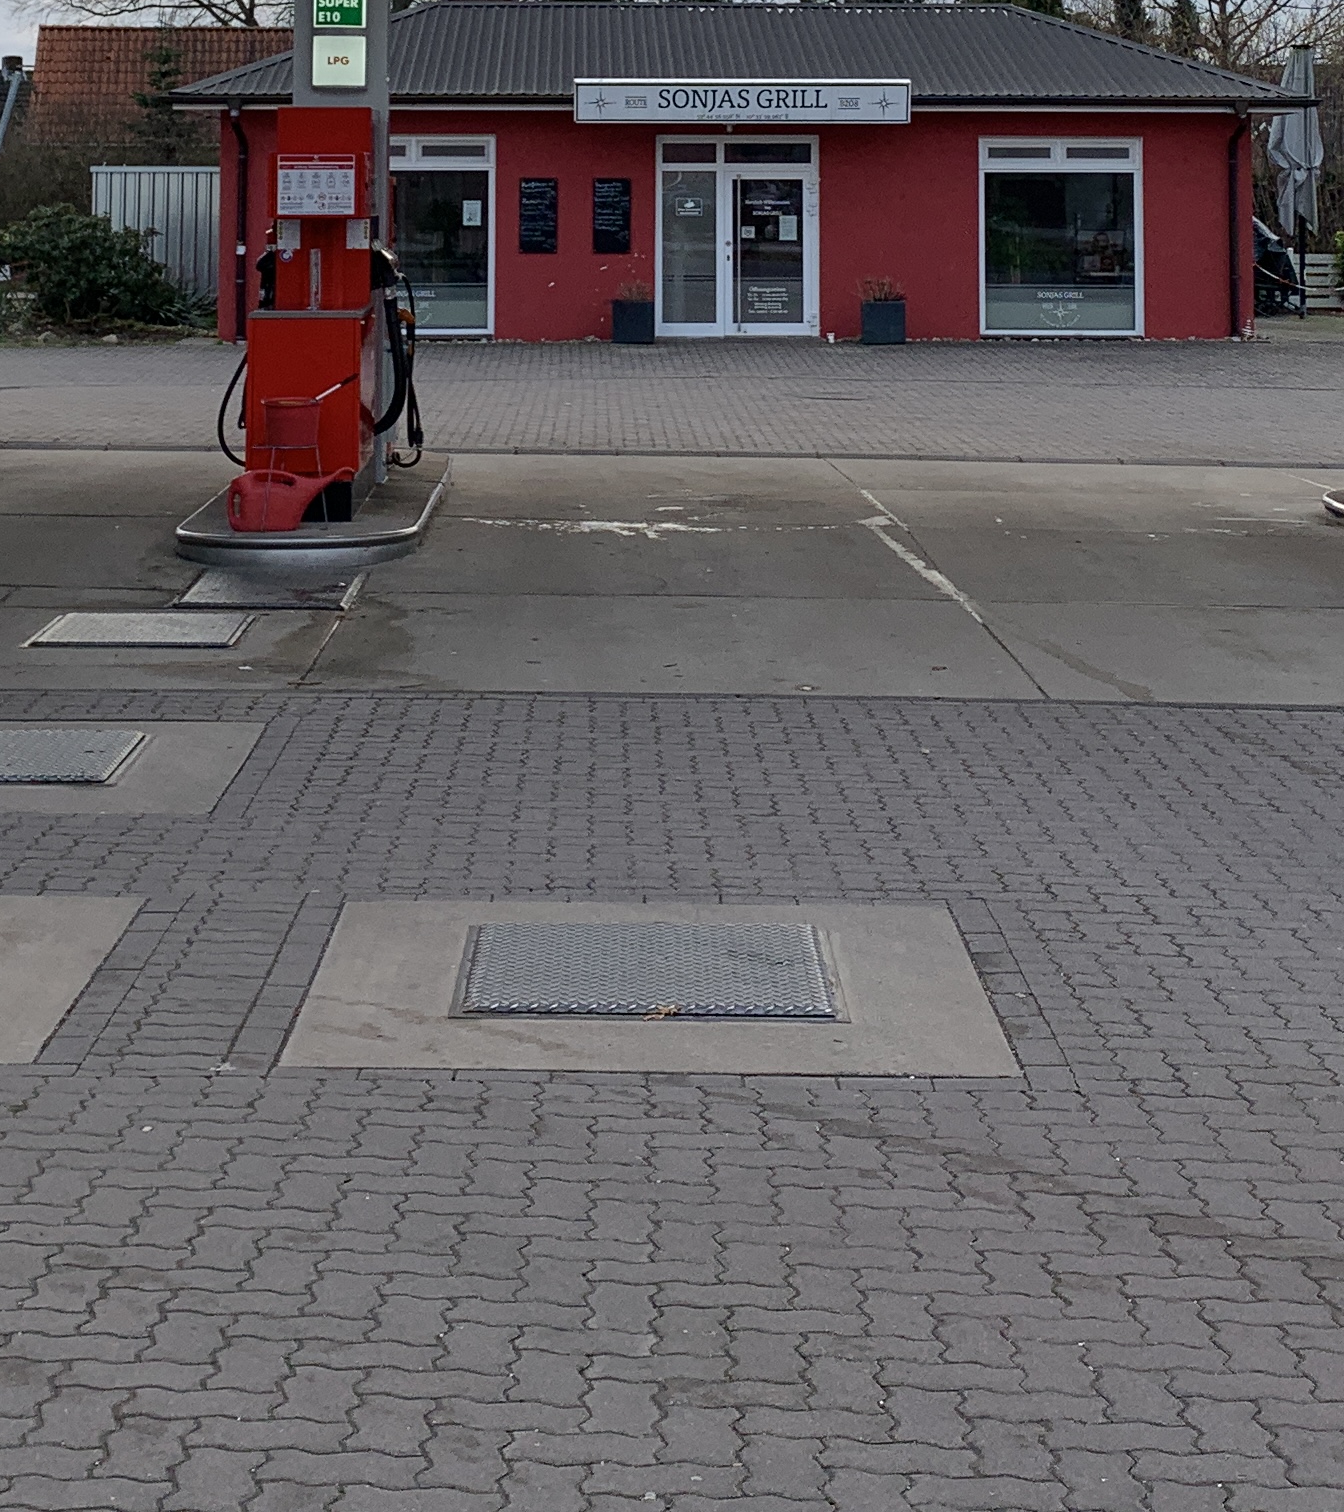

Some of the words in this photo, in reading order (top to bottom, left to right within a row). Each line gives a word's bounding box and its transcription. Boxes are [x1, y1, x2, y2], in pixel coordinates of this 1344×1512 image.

[318, 12, 341, 23] E10
[327, 55, 350, 66] LPG
[625, 99, 647, 107] ROUTE
[658, 88, 750, 111] SONJAS
[756, 88, 828, 109] GRILL
[839, 99, 859, 108] B208
[1037, 291, 1063, 299] SONJAS
[1064, 291, 1084, 299] GRILL
